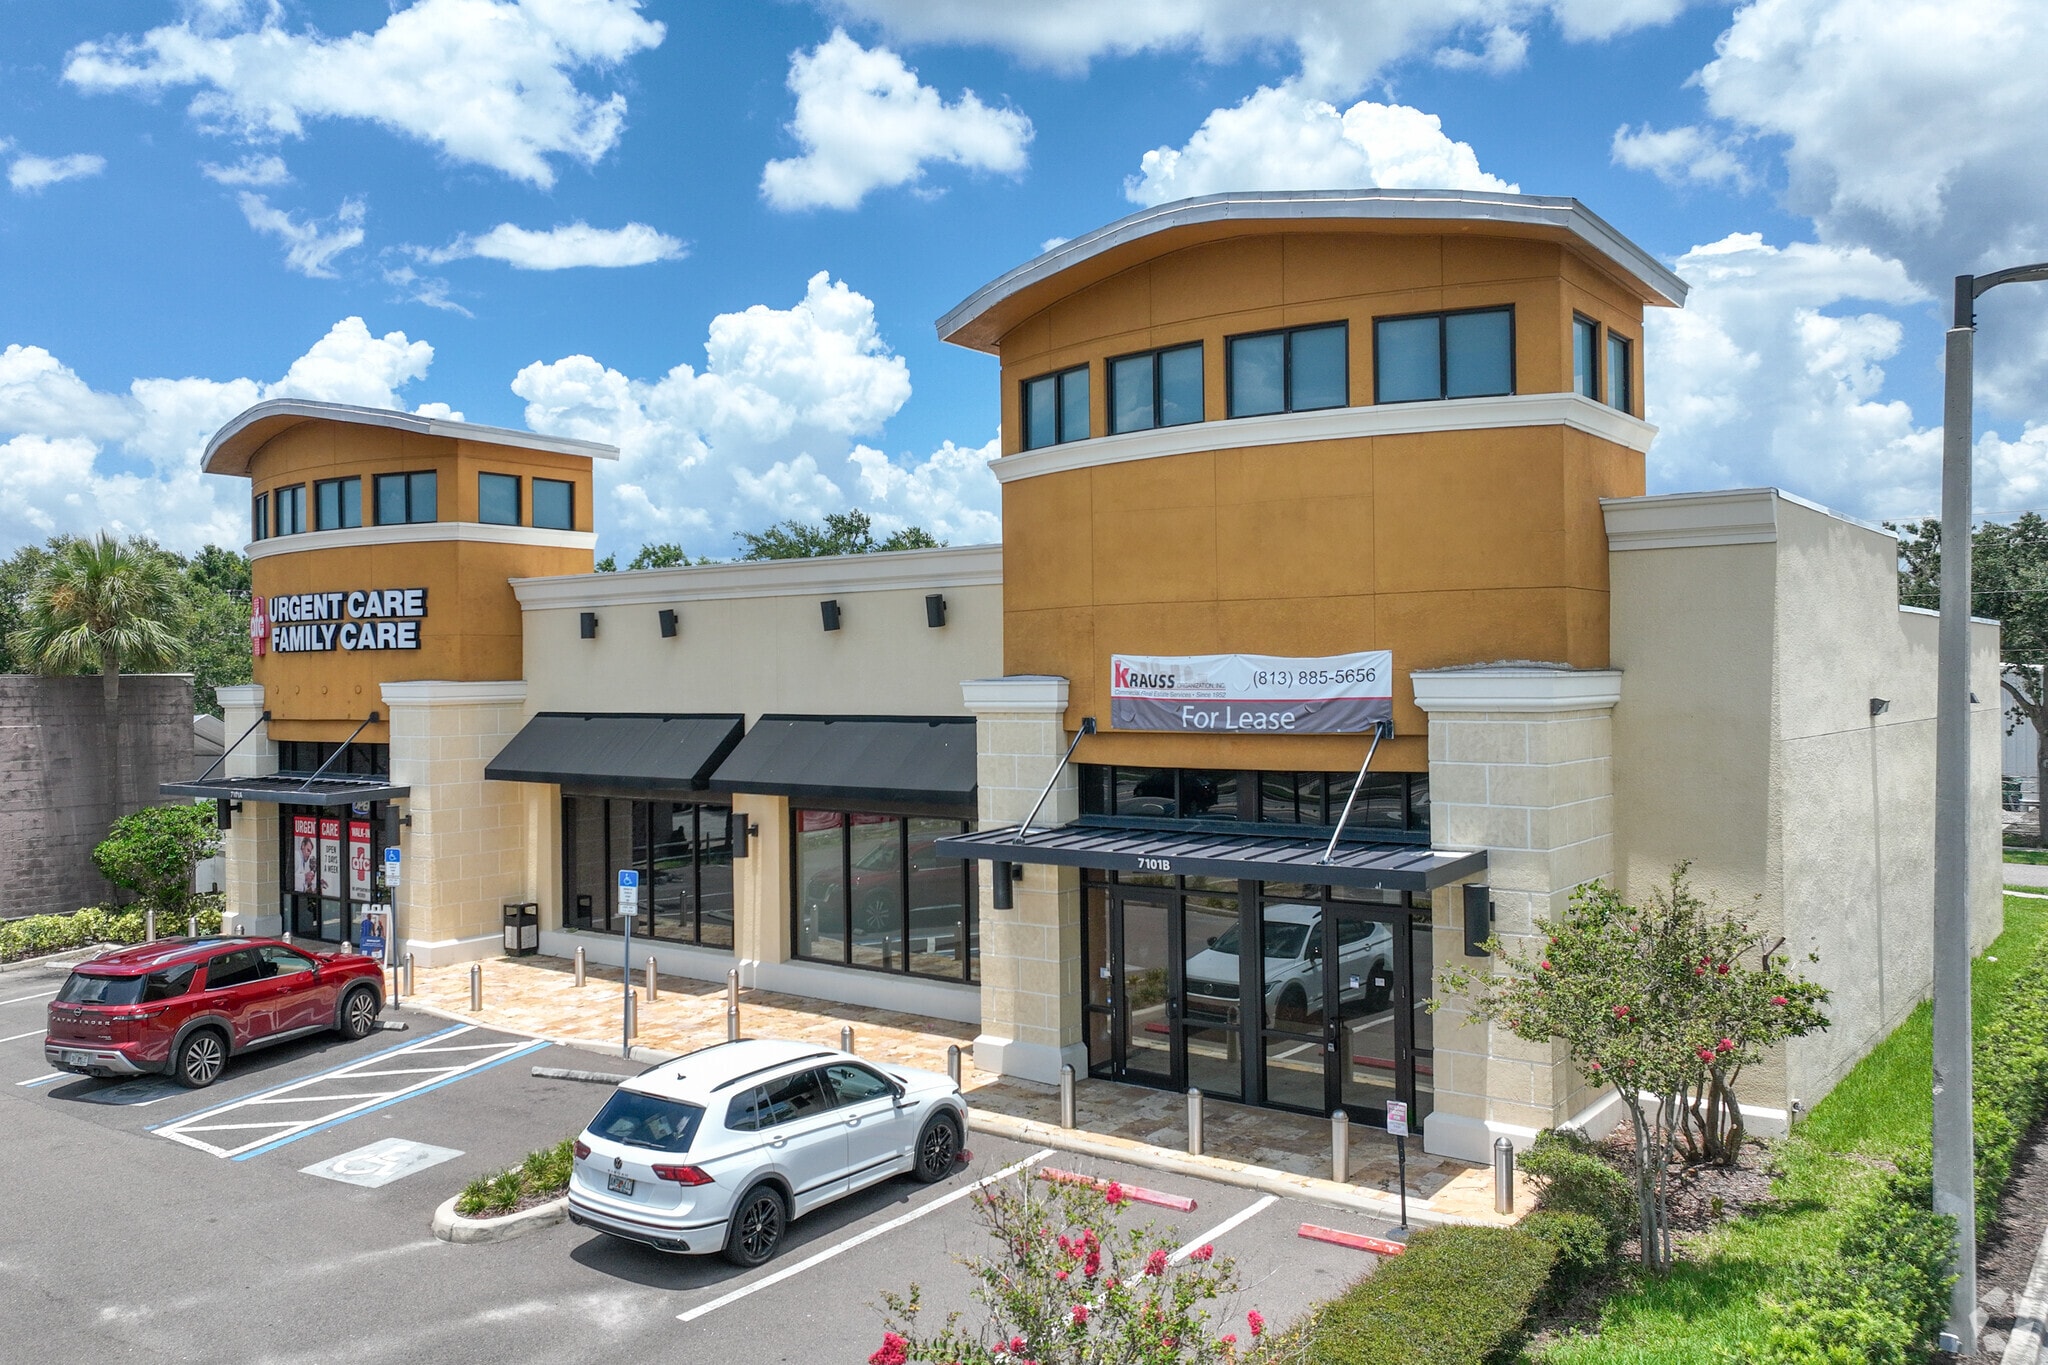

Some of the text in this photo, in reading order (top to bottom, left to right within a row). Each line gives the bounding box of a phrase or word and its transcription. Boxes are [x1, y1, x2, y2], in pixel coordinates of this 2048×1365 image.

[269, 590, 424, 622] URGENT CARE
[271, 622, 418, 652] FAMILY CARE
[1114, 660, 1176, 689] KRAUSS
[1253, 667, 1376, 689] (813) 885-5656
[1182, 705, 1296, 730] For Lease
[295, 819, 316, 835] URGENT
[321, 822, 339, 837] CARE
[326, 845, 336, 853] OPEN
[328, 855, 338, 863] DAYS
[352, 853, 371, 870] afc
[1137, 857, 1171, 871] 7101B
[328, 865, 338, 873] WEEK
[52, 1016, 111, 1026] PATHFINDER
